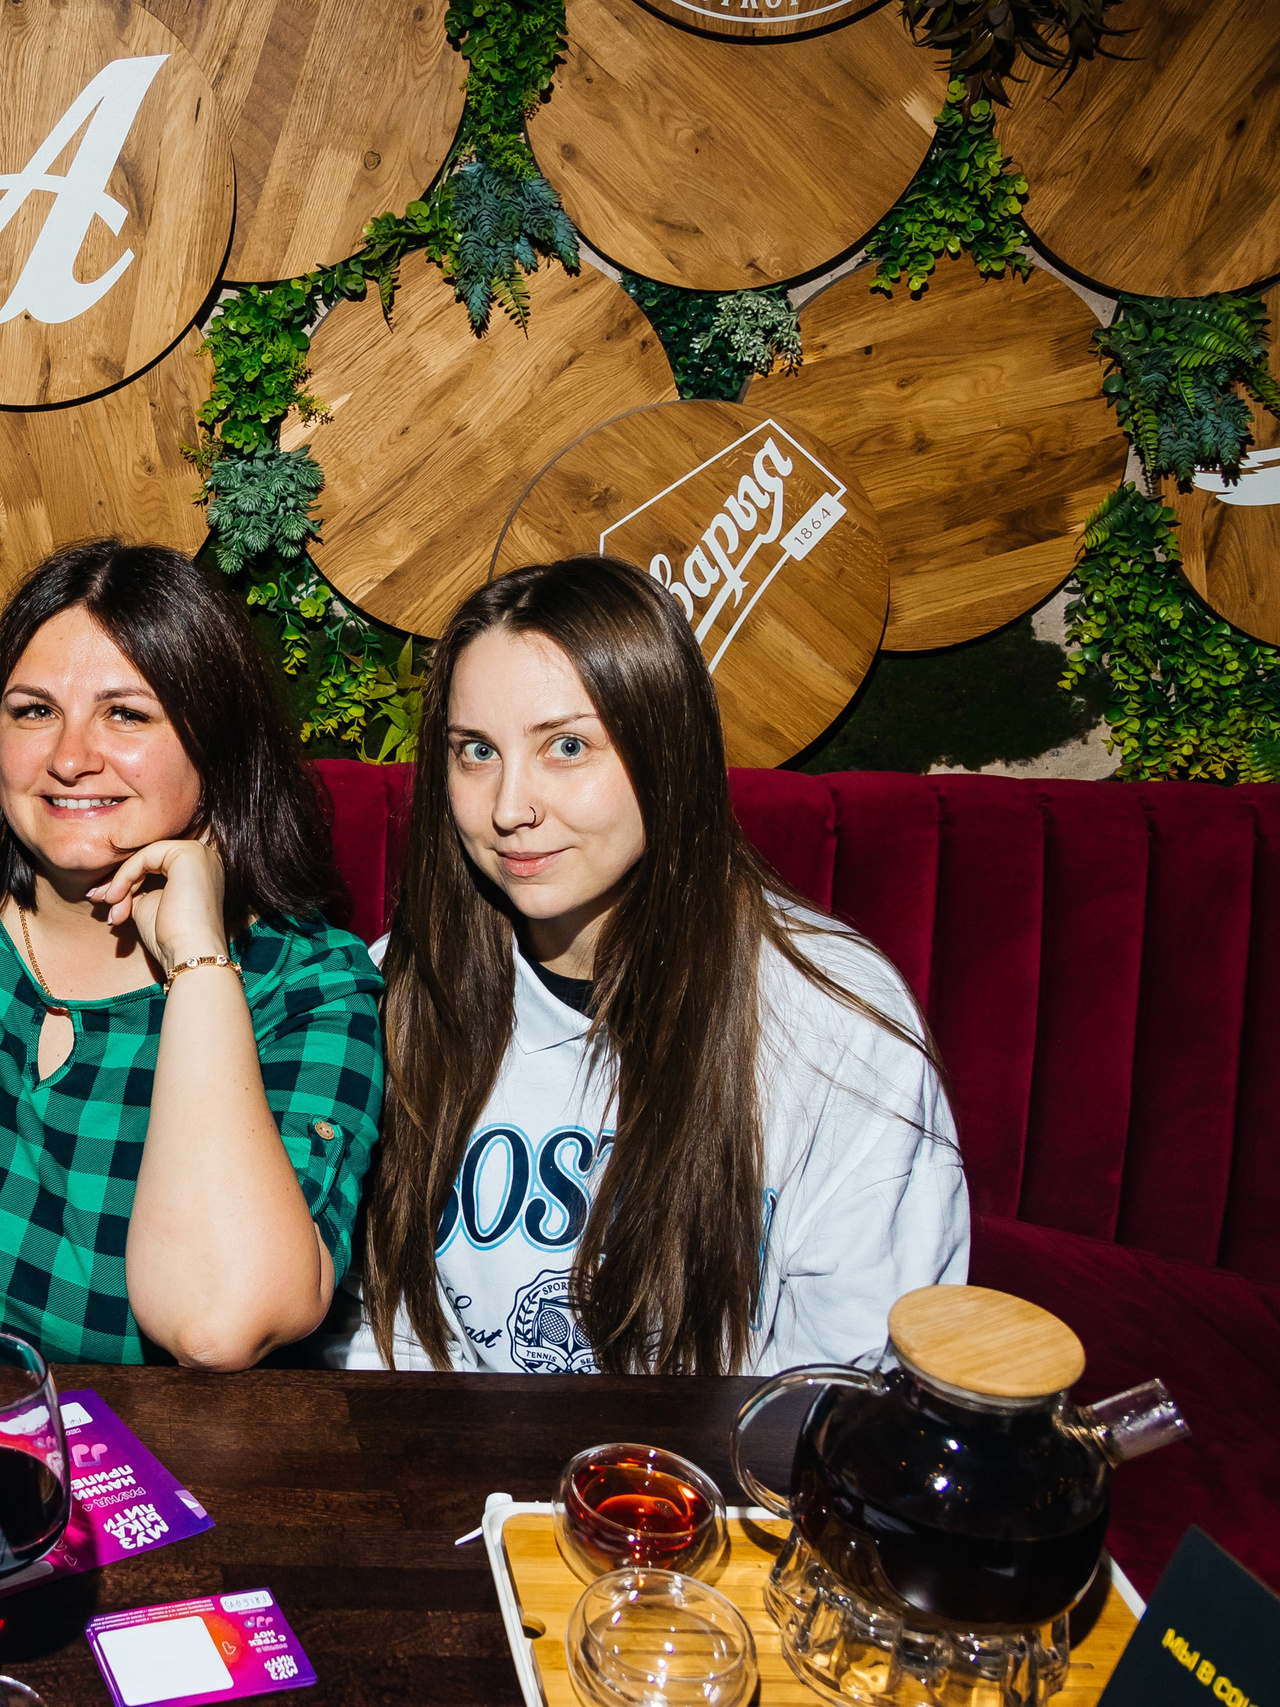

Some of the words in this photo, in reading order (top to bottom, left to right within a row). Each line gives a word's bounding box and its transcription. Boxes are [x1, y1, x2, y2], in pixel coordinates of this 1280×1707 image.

[794, 507, 832, 547] 1864
[525, 1350, 558, 1364] TENNIS
[70, 1464, 134, 1491] ПРИПЕ
[72, 1475, 136, 1500] НАЧНИ
[92, 1486, 146, 1508] РАУНД
[103, 1503, 155, 1533] ЛИТИ
[110, 1510, 162, 1539] ЫКА
[118, 1519, 169, 1549] МУЗ
[248, 1636, 277, 1647] ТРЕХ
[253, 1629, 275, 1639] НОТ
[277, 1634, 286, 1642] С
[1161, 1628, 1201, 1672] МЫ
[1195, 1659, 1217, 1686] В
